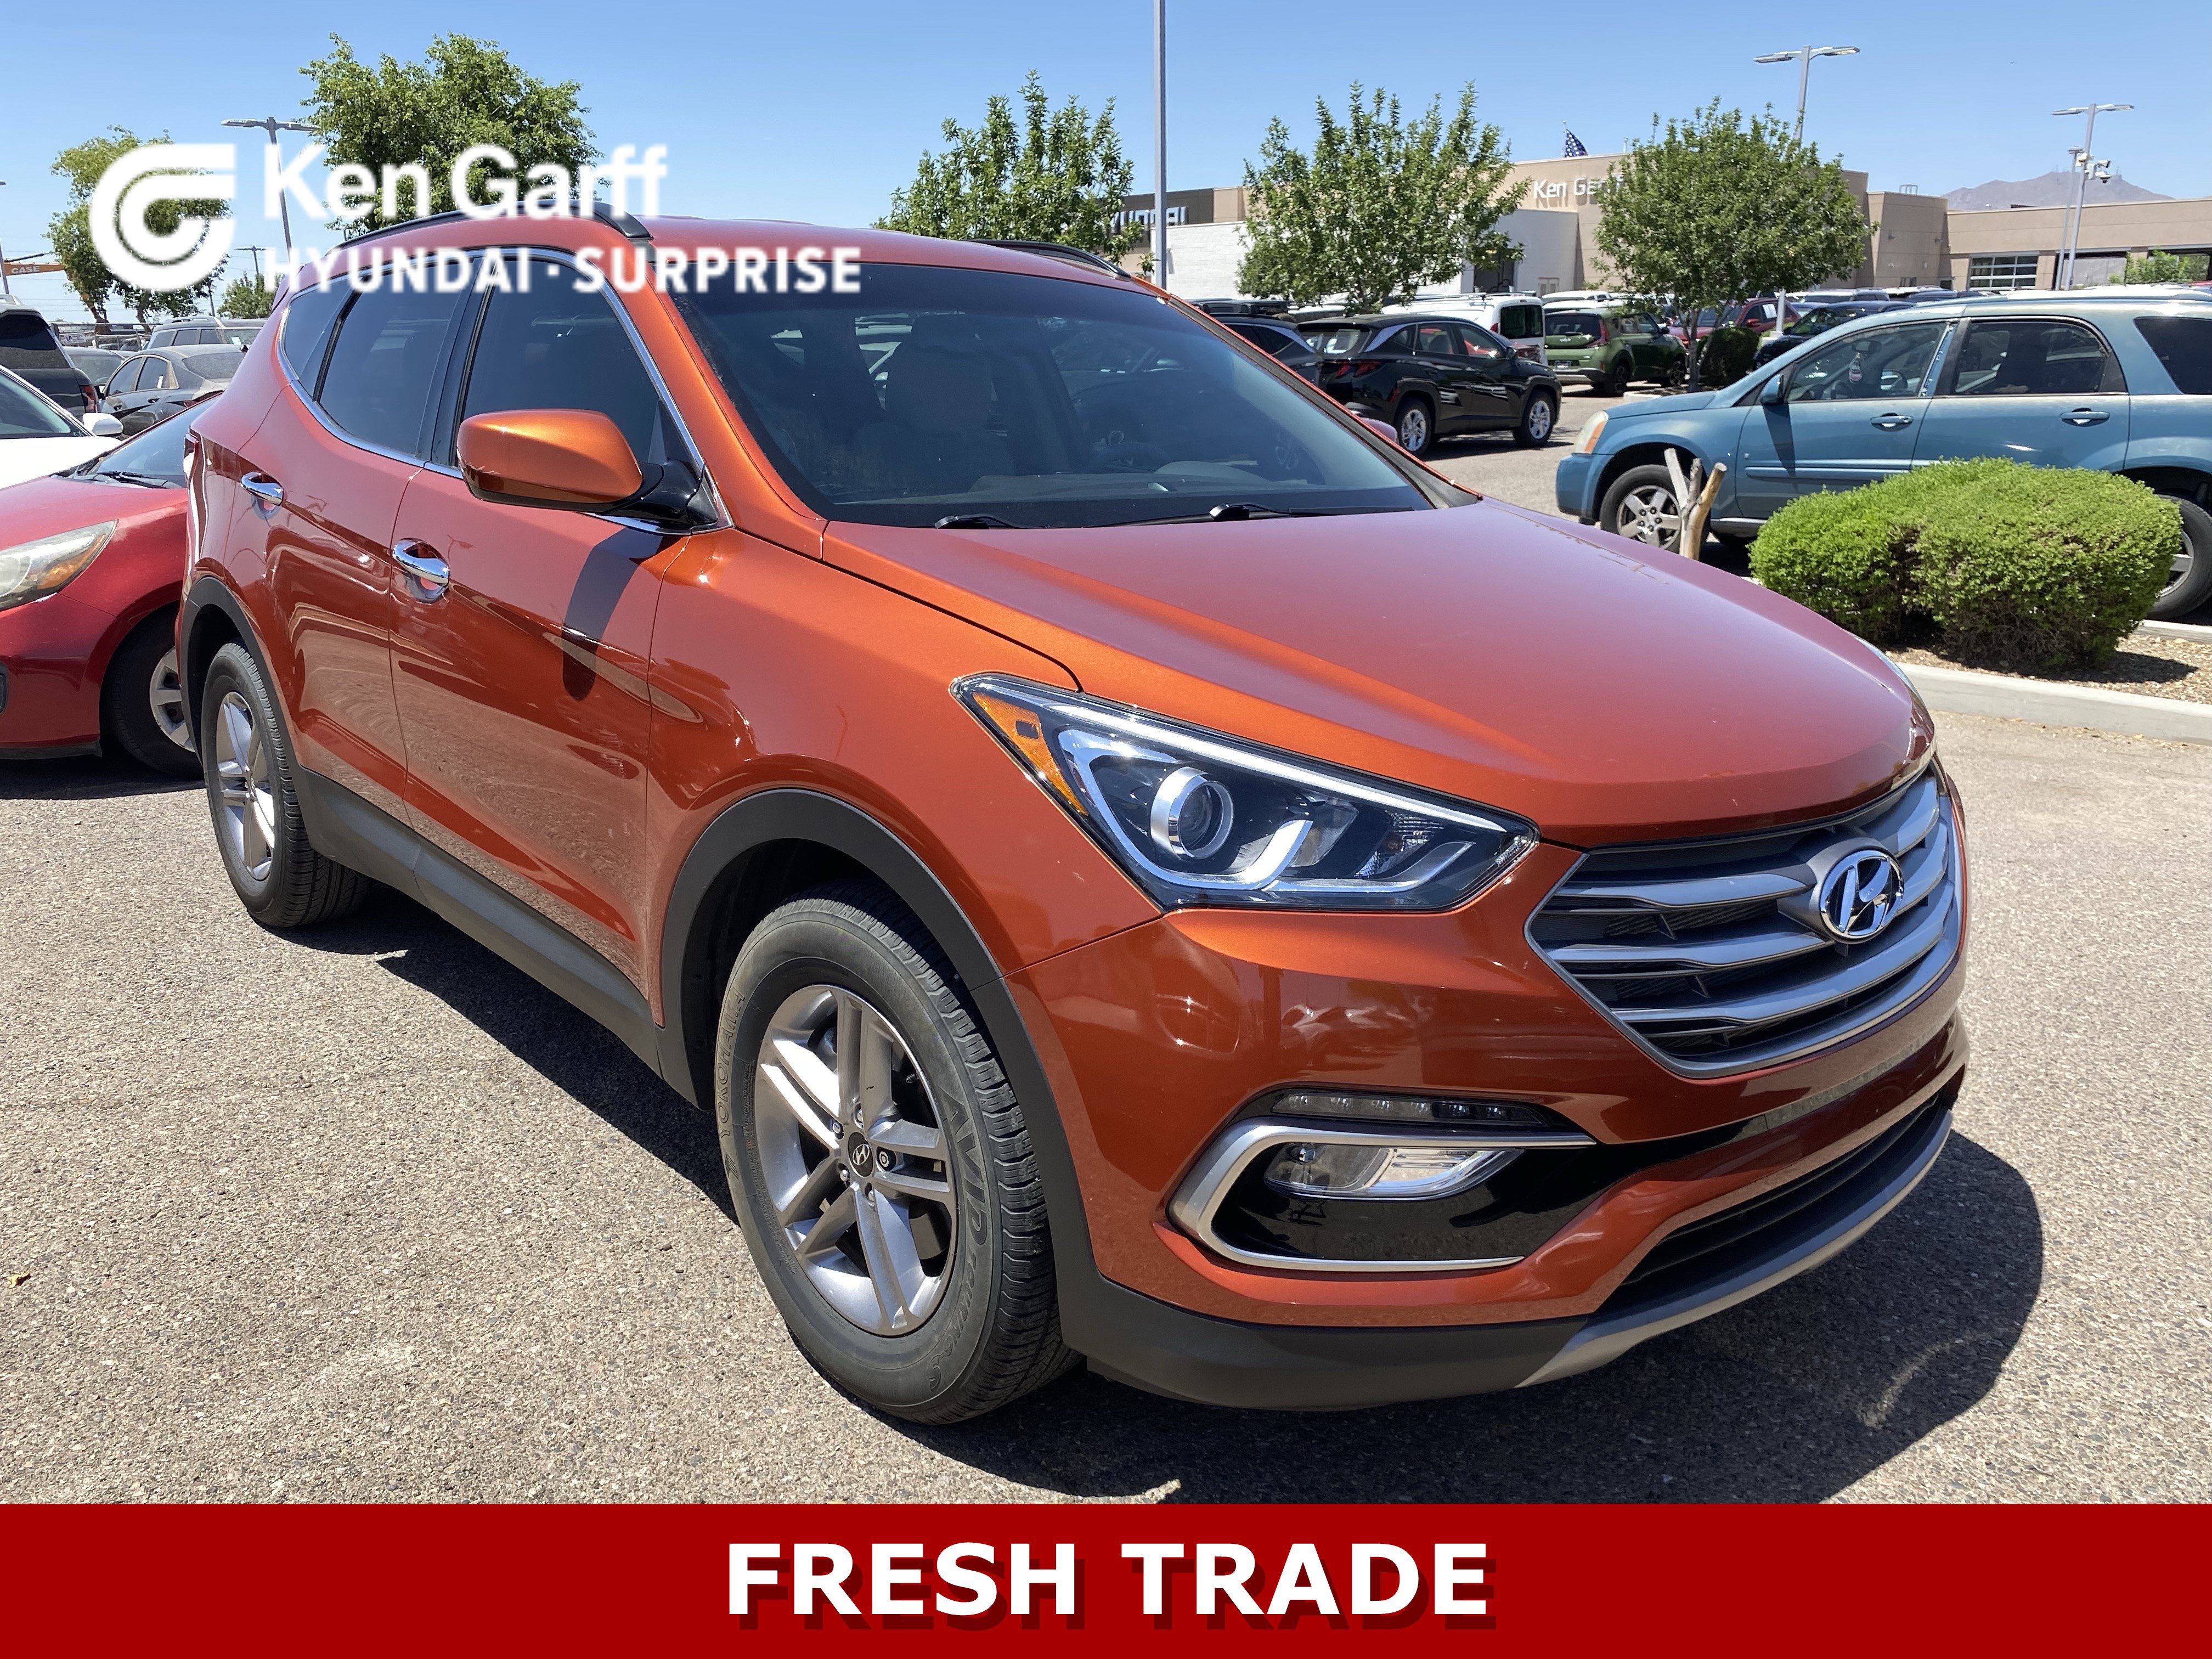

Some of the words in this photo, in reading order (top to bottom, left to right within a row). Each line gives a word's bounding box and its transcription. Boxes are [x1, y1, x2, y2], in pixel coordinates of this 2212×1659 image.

[1532, 179, 1567, 199] Ken
[11, 266, 40, 274] CASE
[716, 991, 746, 1138] YOKOHAMA
[939, 1086, 988, 1245] AVID
